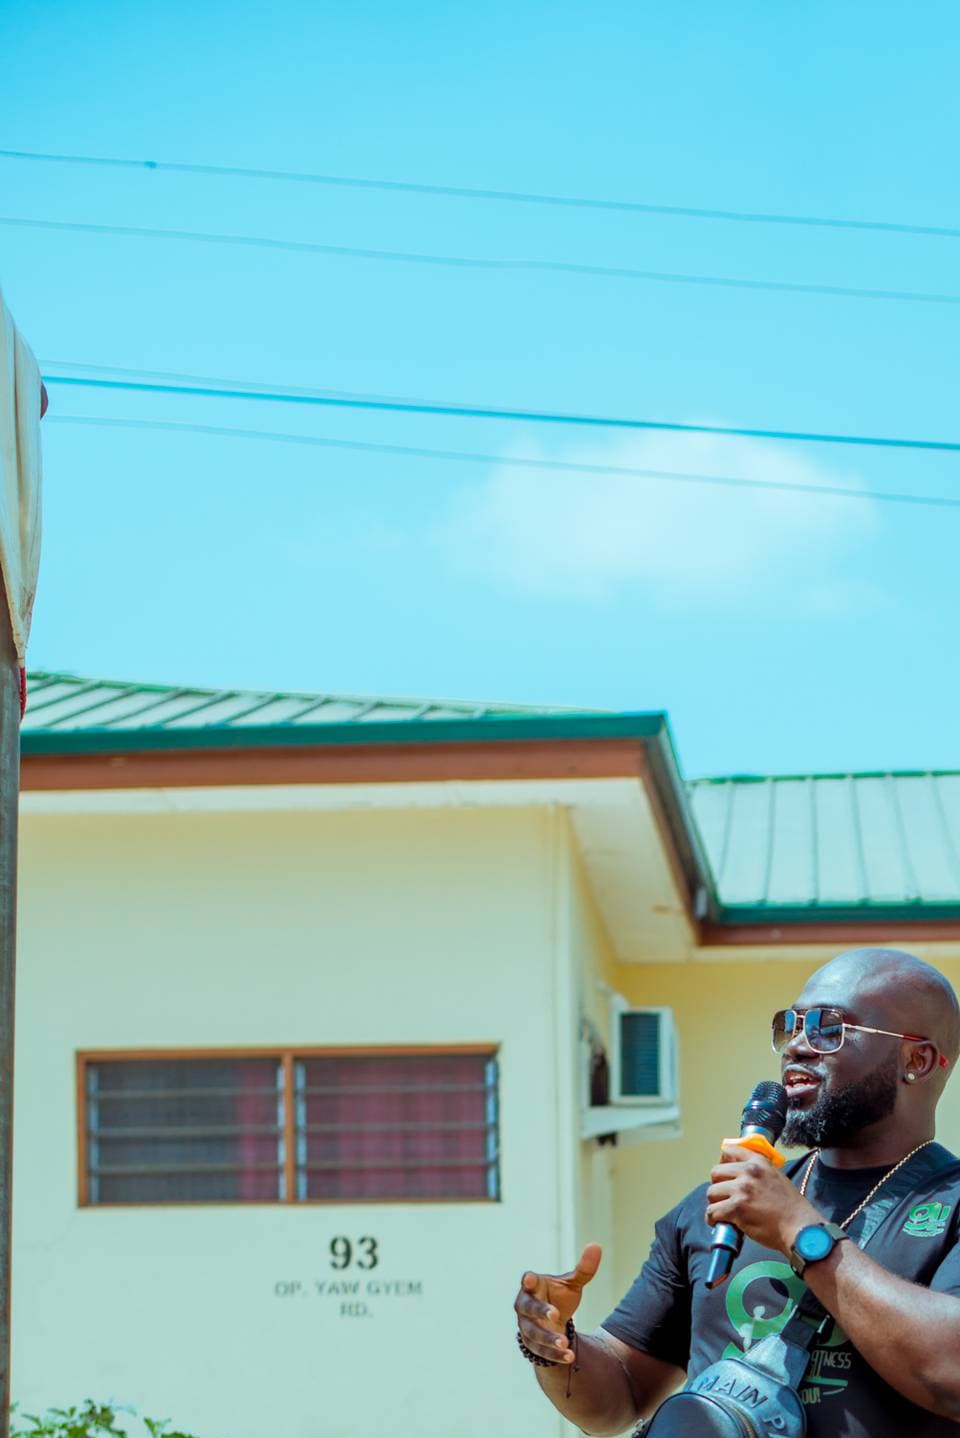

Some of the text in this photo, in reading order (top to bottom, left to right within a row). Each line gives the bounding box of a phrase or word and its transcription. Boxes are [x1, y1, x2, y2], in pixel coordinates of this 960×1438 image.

[329, 1236, 378, 1270] 93
[315, 1280, 360, 1296] YAW
[688, 1374, 769, 1409] MAIN
